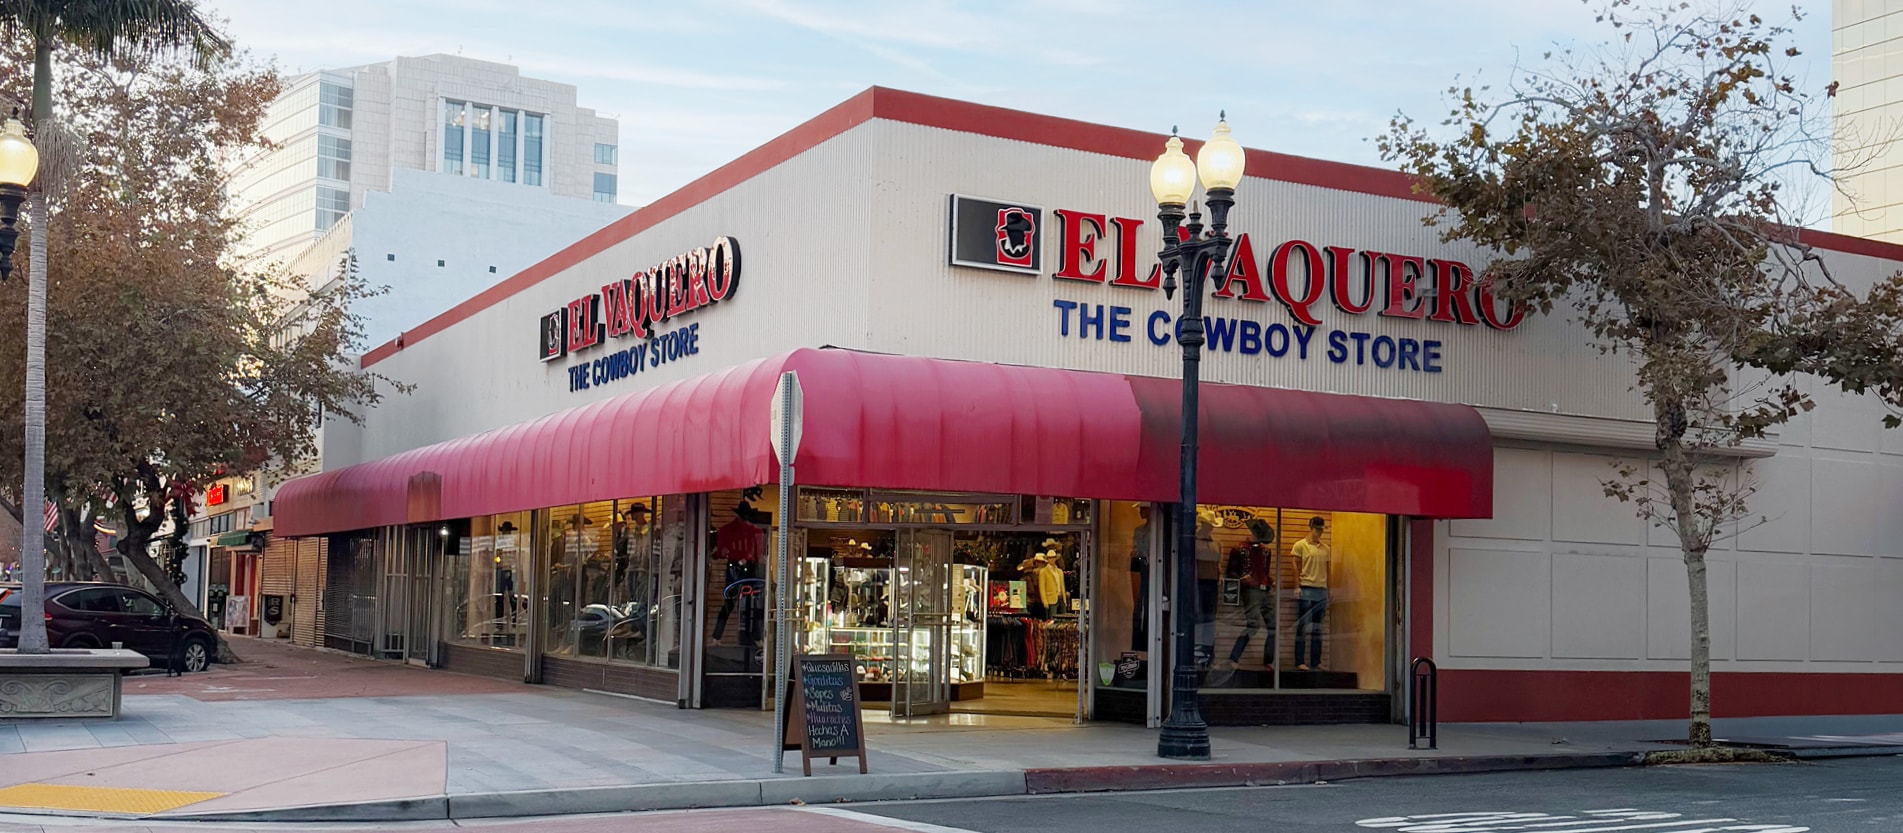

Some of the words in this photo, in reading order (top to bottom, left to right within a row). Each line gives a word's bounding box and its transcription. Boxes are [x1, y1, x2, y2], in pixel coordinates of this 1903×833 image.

[567, 294, 604, 353] EL
[601, 235, 741, 340] VAQUERO
[1053, 208, 1161, 289] EL
[1170, 225, 1526, 331] AQUERO
[567, 360, 591, 393] THE
[592, 342, 648, 387] COWBOY
[649, 322, 700, 368] STORE
[1053, 299, 1132, 343] THE
[1147, 310, 1316, 360] CWBOY
[1327, 329, 1442, 373] STORE
[808, 724, 839, 737] Hechas
[840, 724, 850, 737] A
[809, 687, 834, 703] Sopes
[810, 700, 843, 713] Mulitas
